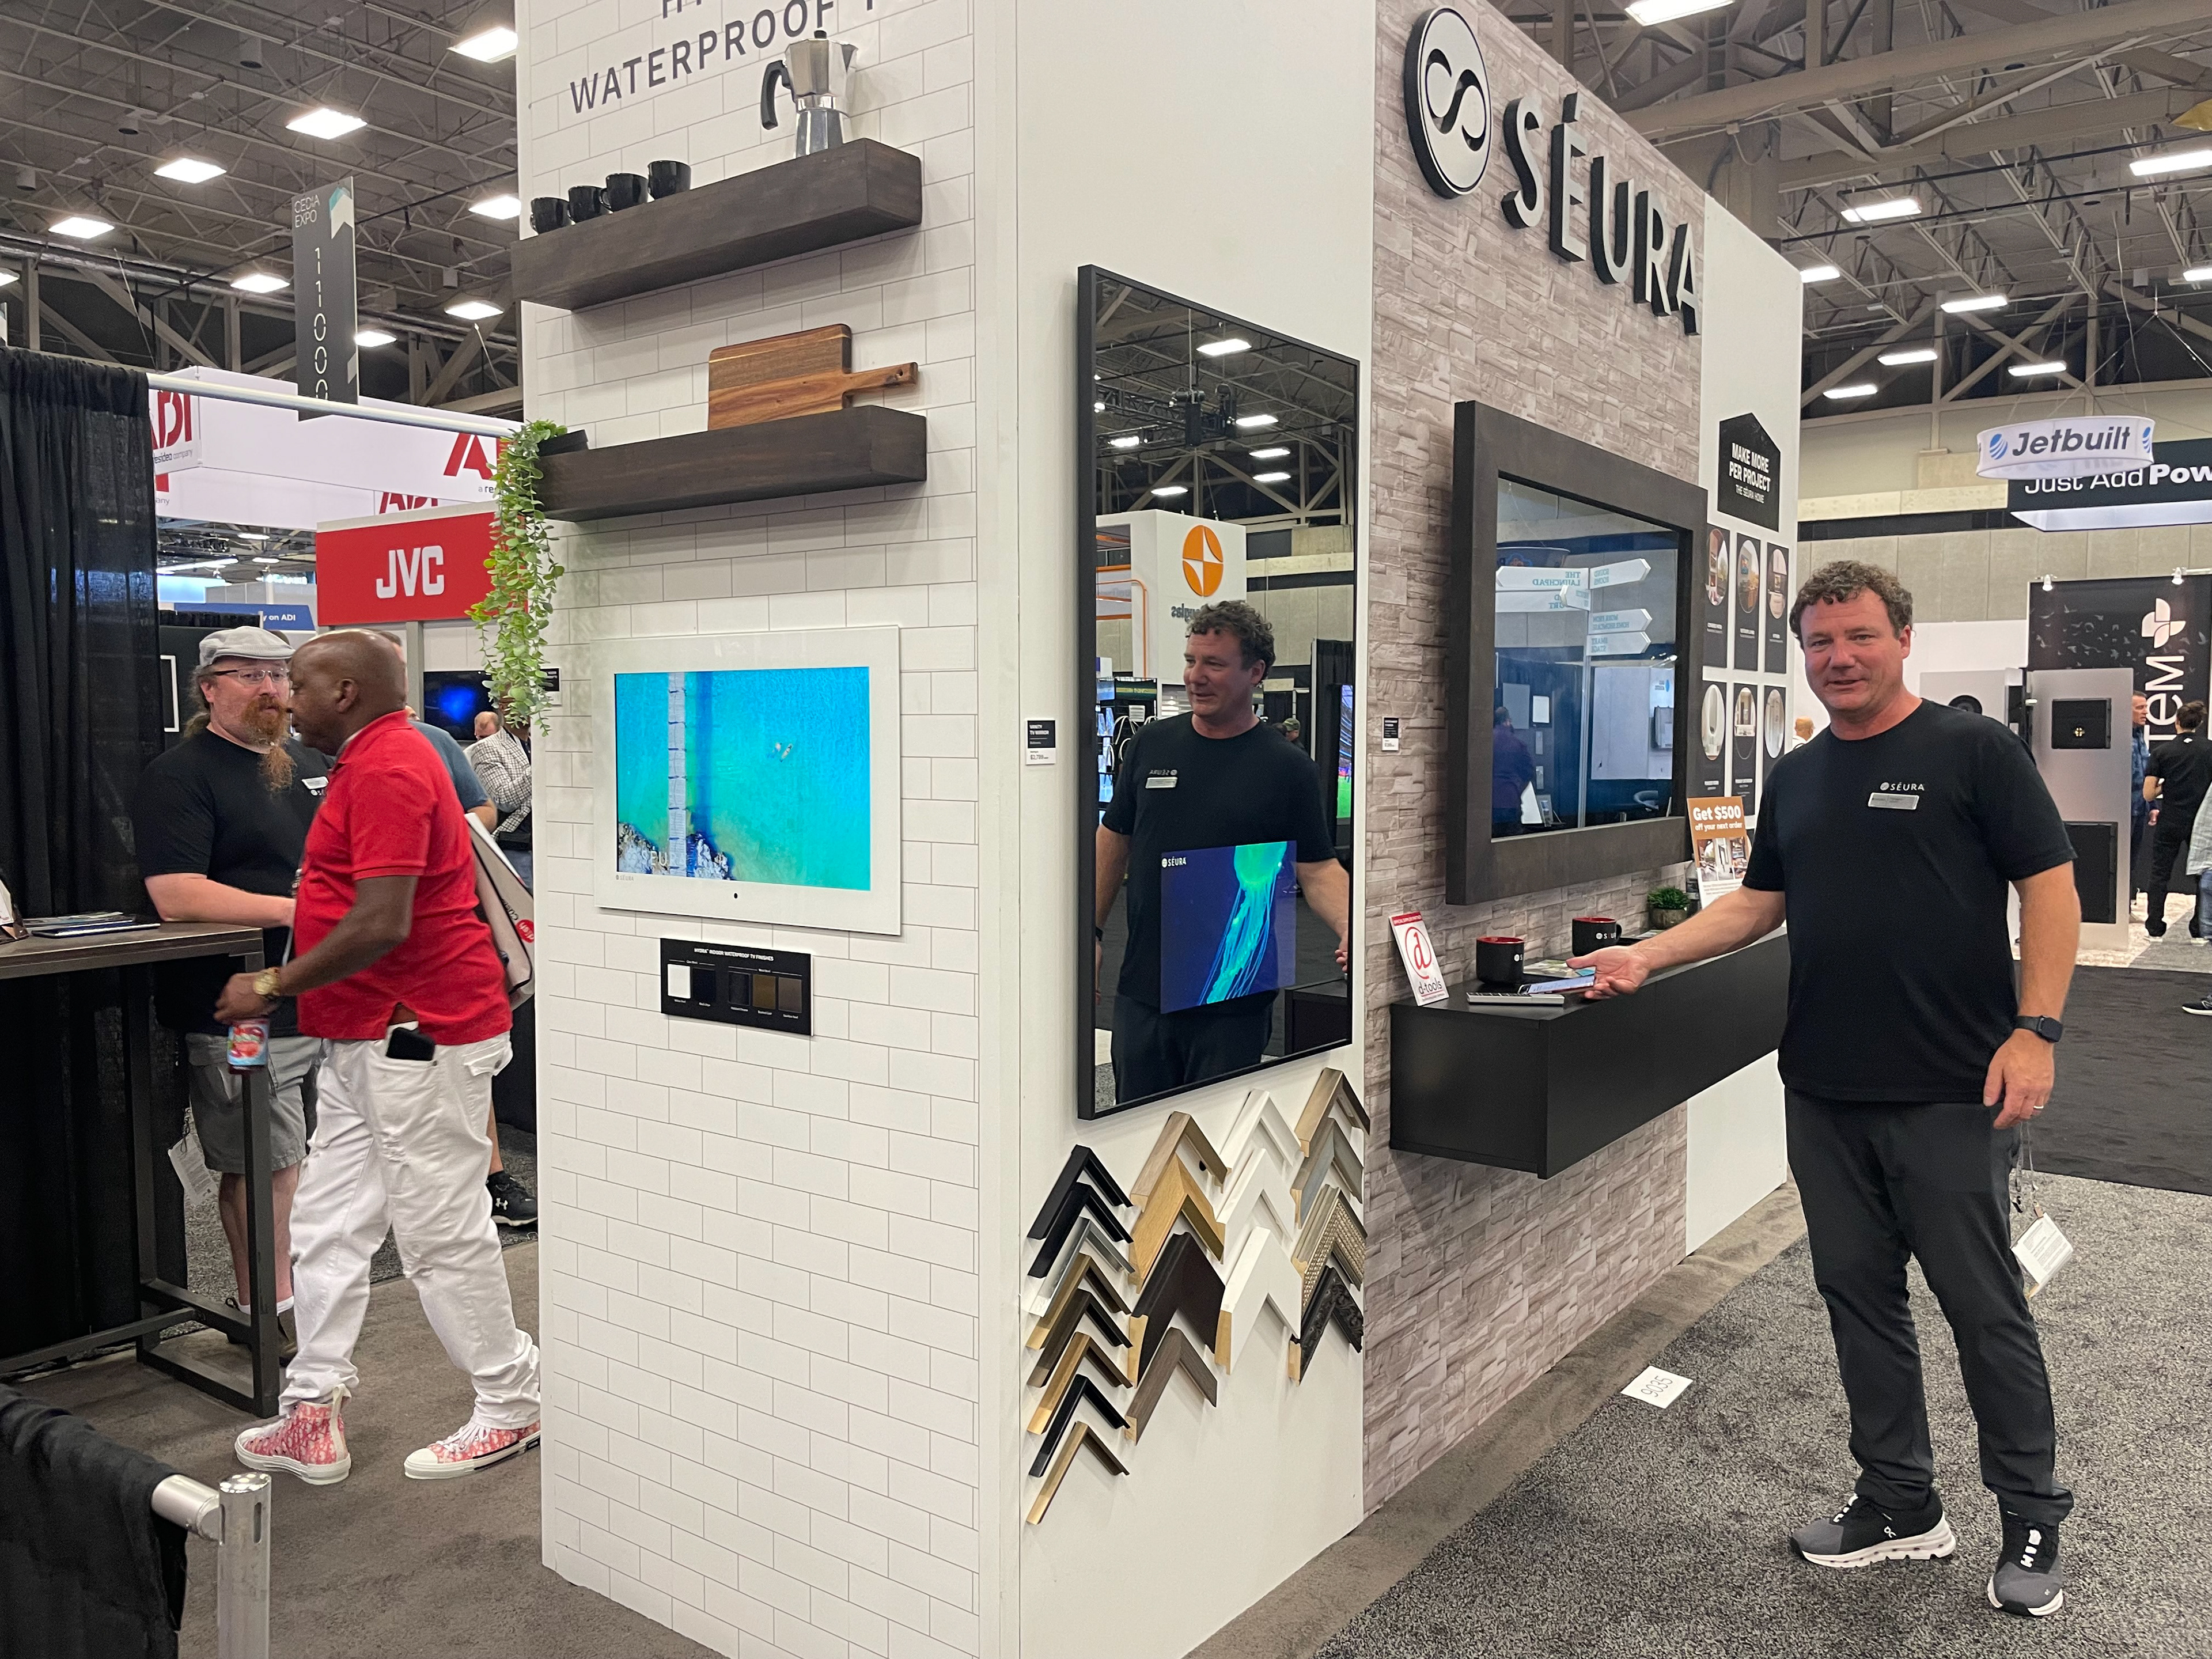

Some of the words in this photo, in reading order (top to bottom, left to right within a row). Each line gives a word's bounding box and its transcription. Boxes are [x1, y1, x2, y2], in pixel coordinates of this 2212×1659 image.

[570, 0, 834, 113] WATERPROOF
[294, 194, 320, 213] CEDIA
[1501, 92, 1700, 336] SÉURA
[295, 209, 317, 228] EXPO
[151, 389, 192, 450] DI
[2012, 426, 2131, 457] Jetbuilt
[154, 452, 172, 464] esideo
[1732, 442, 1751, 465] MAKE
[1751, 452, 1769, 473] MORE
[1729, 461, 1742, 481] PER
[1743, 467, 1771, 492] PROJECT
[2025, 477, 2083, 494] Just
[2090, 468, 2143, 489] Add
[376, 545, 445, 599] JVC
[1890, 782, 1925, 791] SÉURA
[1693, 807, 1714, 821] Get
[1714, 805, 1741, 821] $500
[1704, 824, 1716, 832] your
[1168, 856, 1187, 867] SÉURA
[1418, 977, 1442, 995] d-tools
[1641, 1376, 1673, 1397] 9035
